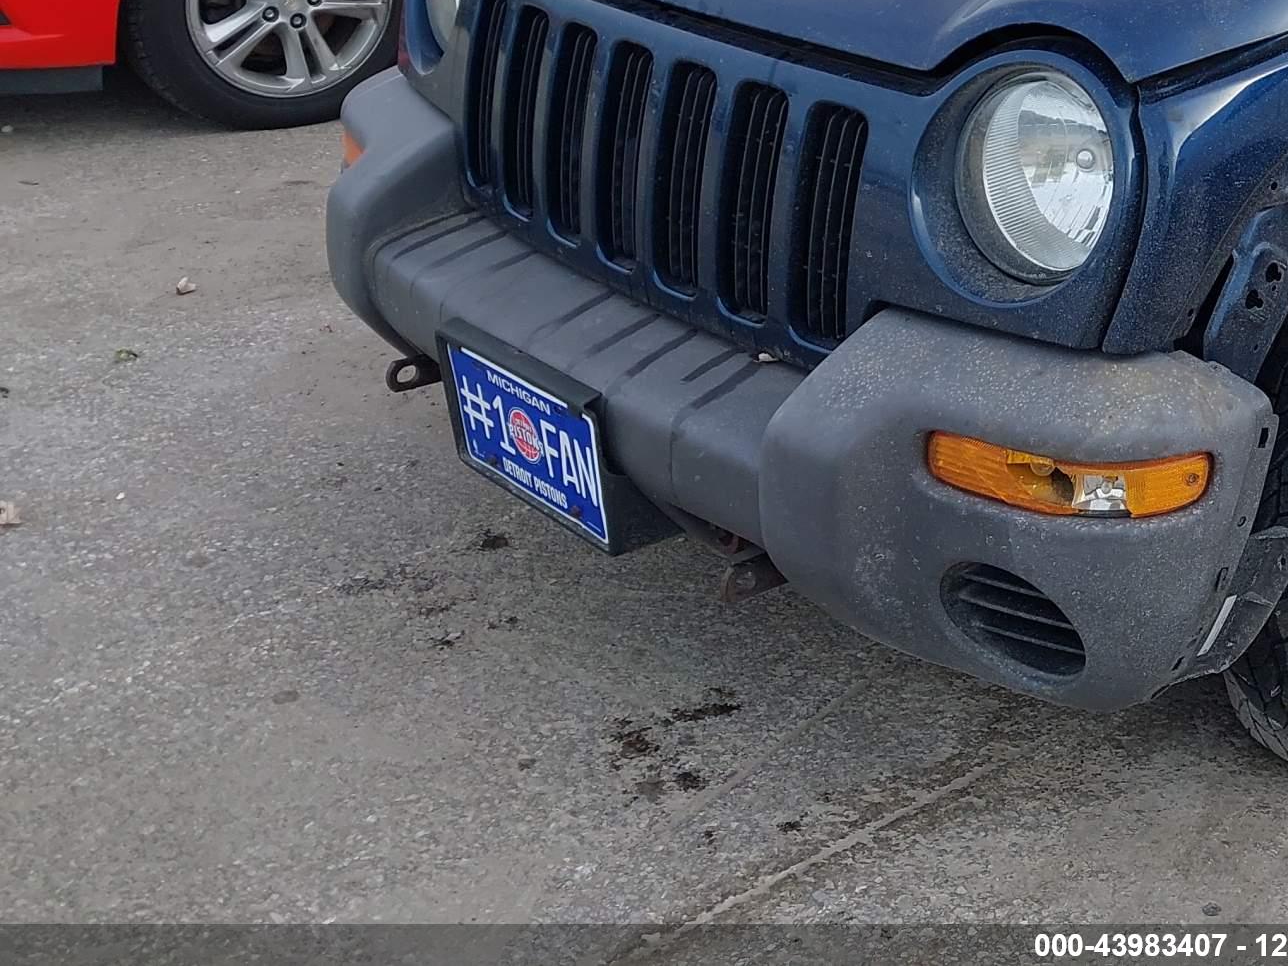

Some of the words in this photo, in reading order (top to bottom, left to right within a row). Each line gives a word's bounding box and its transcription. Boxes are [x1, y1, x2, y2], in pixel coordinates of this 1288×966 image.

[486, 369, 551, 416] MICHIGAN
[460, 375, 516, 455] #1
[539, 419, 598, 507] FAN
[502, 456, 533, 488] DETROIT
[533, 475, 568, 509] PISTONS
